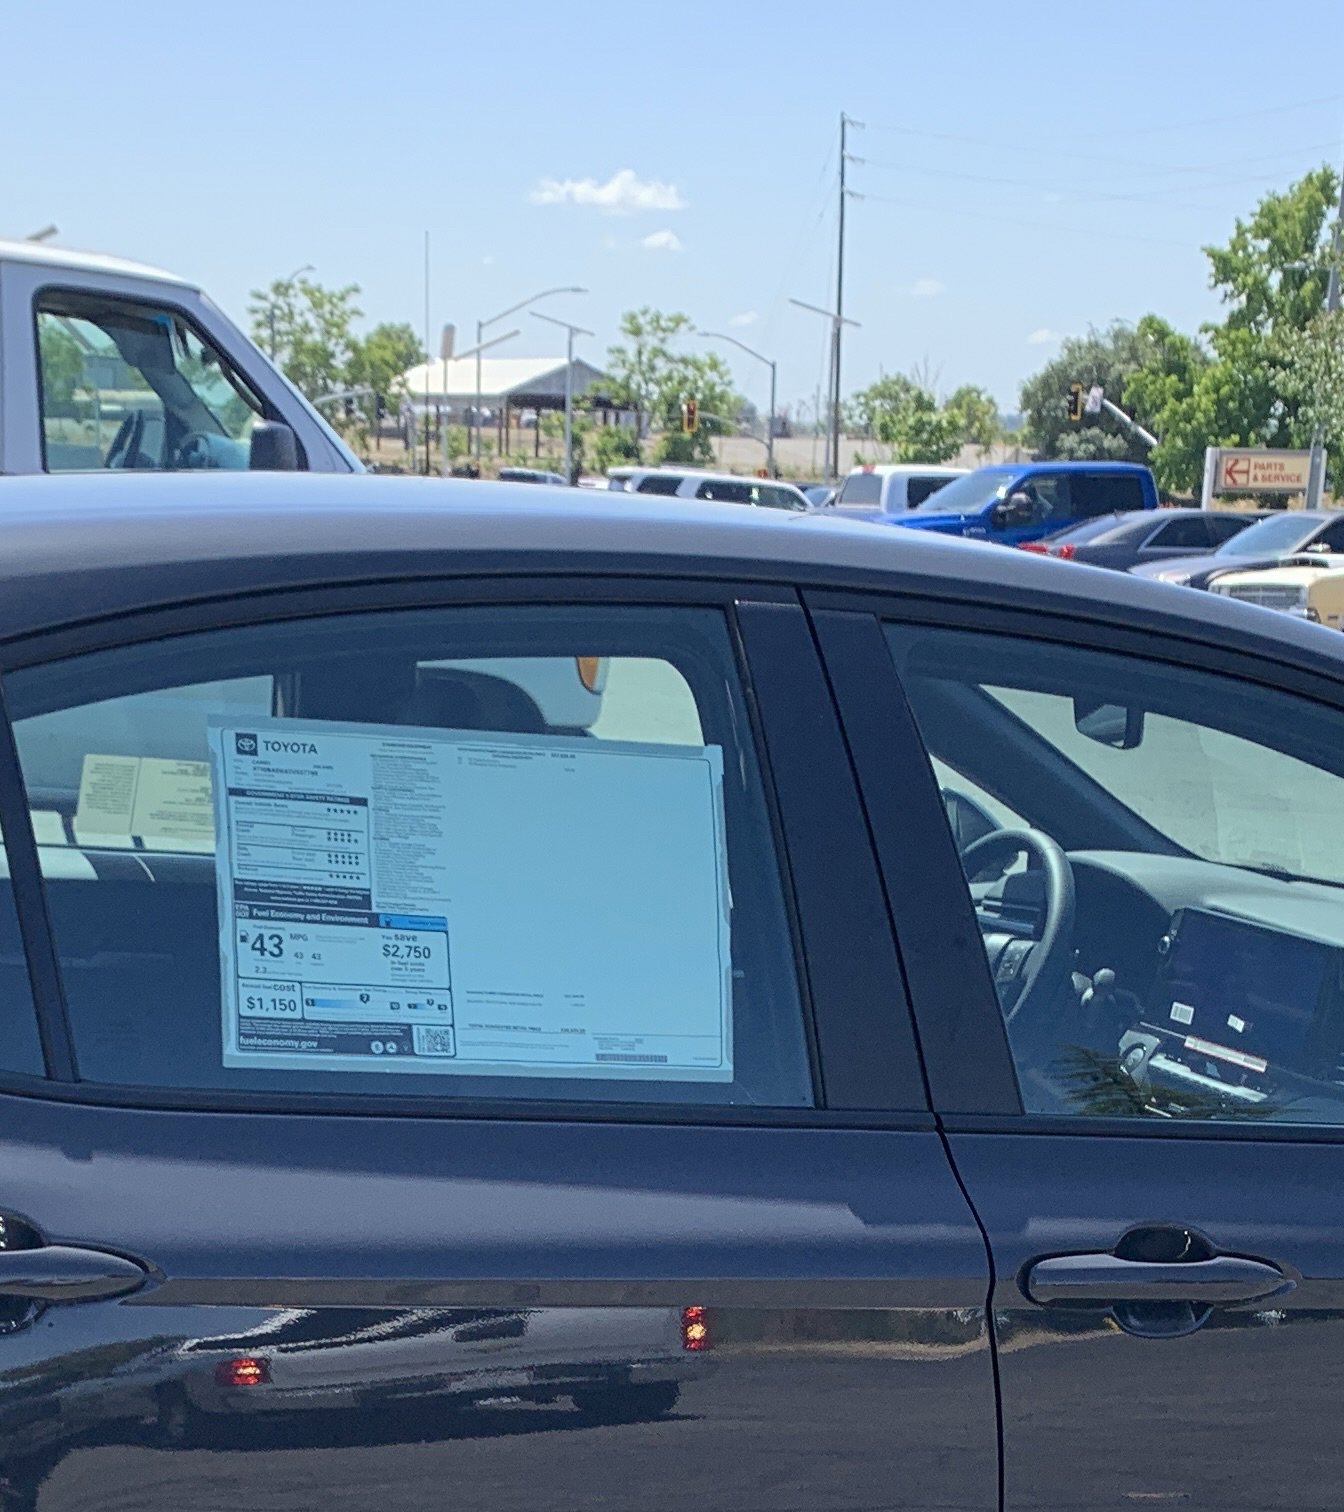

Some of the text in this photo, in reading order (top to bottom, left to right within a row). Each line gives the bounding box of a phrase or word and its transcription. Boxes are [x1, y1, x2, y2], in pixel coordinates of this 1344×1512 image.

[1254, 462, 1285, 472] PARTS
[1261, 473, 1303, 484] SERVICE
[263, 740, 318, 755] TOYOTA
[252, 908, 369, 924] Fuel Economy and Environment
[394, 933, 418, 942] save
[251, 932, 284, 958] 43
[289, 932, 309, 942] MPG
[382, 943, 431, 960] $2,750
[294, 951, 322, 961] 43 43
[273, 983, 296, 993] cost
[246, 995, 298, 1013] $1,150
[239, 1036, 319, 1049] fueleconomy.gov
